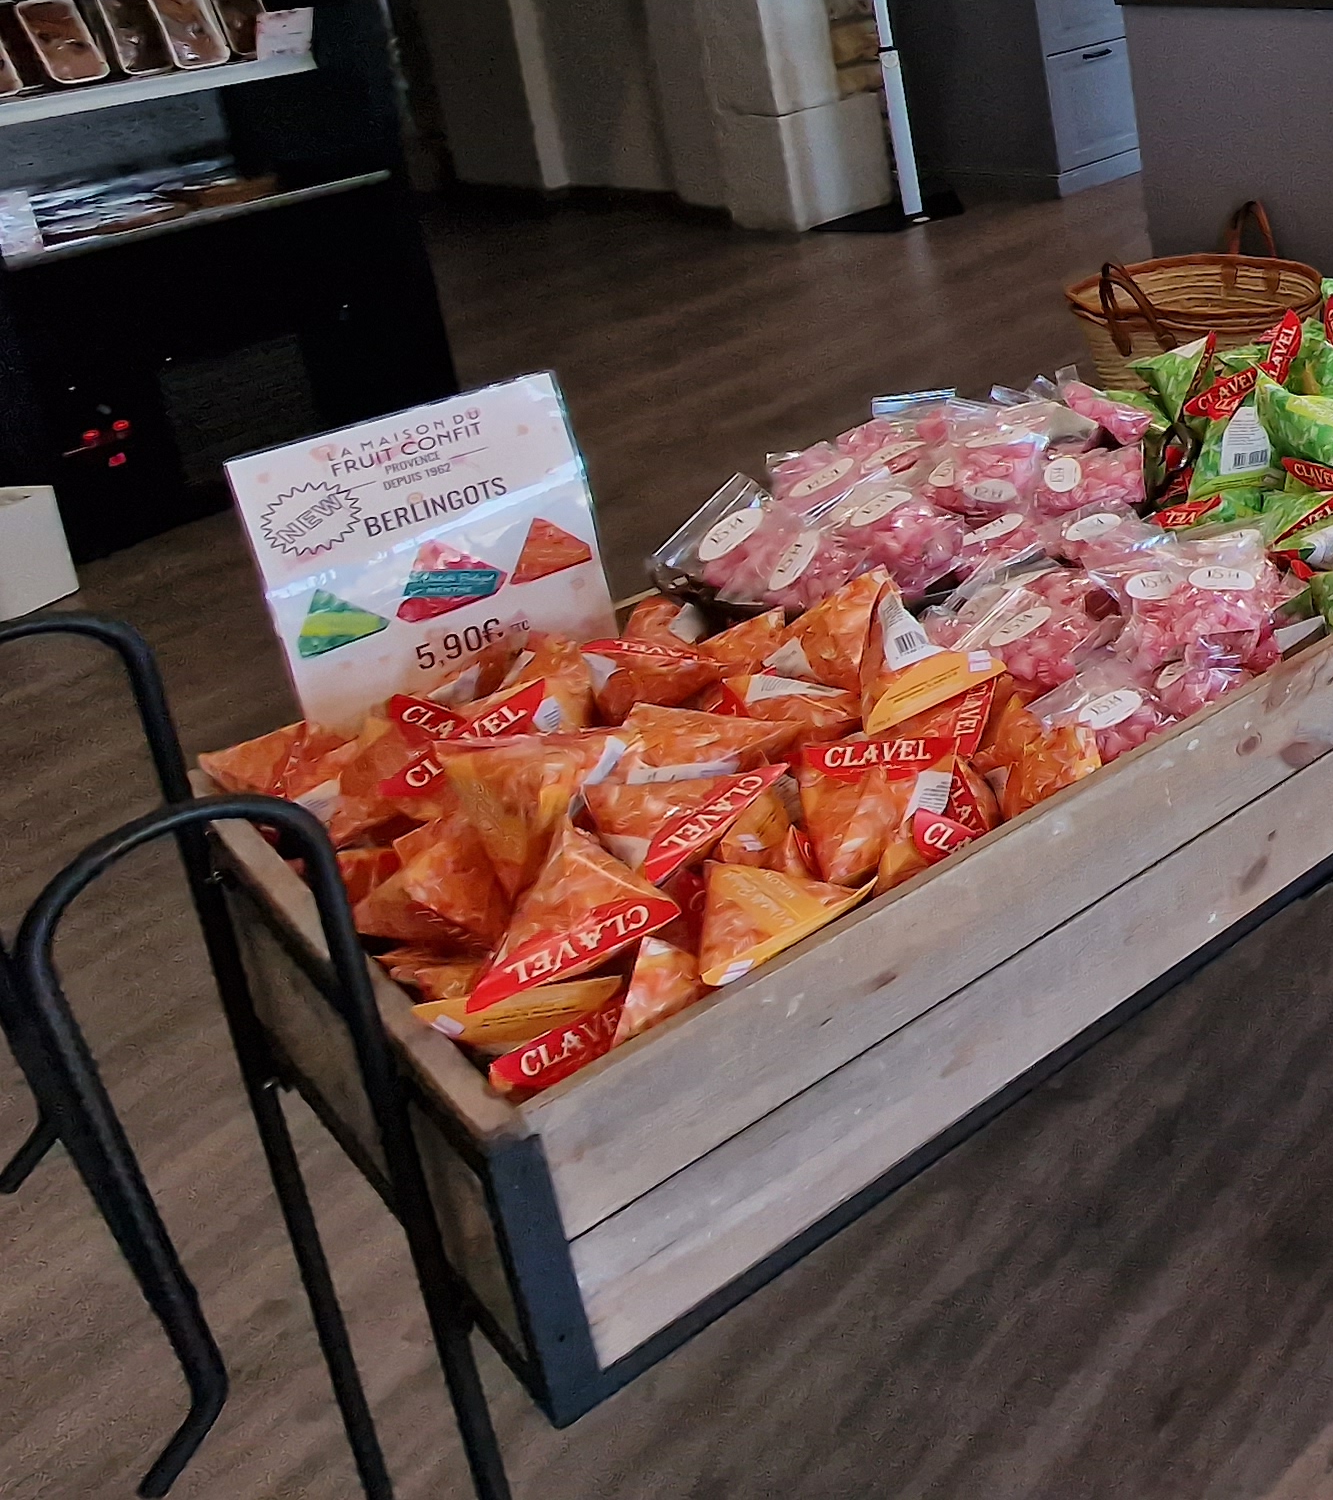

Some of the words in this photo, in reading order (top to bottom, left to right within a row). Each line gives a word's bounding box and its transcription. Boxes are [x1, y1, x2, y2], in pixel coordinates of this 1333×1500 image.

[1268, 325, 1299, 381] LAVEL
[326, 447, 353, 462] LA
[360, 419, 445, 451] MAISON
[452, 409, 480, 426] DU
[331, 447, 393, 477] FRUIT
[400, 421, 482, 456] CONFIT
[383, 472, 423, 491] DEPUIS
[425, 462, 451, 479] 1962
[384, 450, 440, 475] PROVENCE
[275, 493, 343, 545] NEW
[363, 476, 508, 538] BERLINGOTS
[1165, 509, 1198, 525] VEL
[414, 618, 504, 671] 5,90€
[824, 739, 932, 768] CLAVEL
[659, 775, 763, 851] CLAVEL
[503, 904, 649, 984] CLAVEL
[520, 1007, 619, 1077] CLAVE
